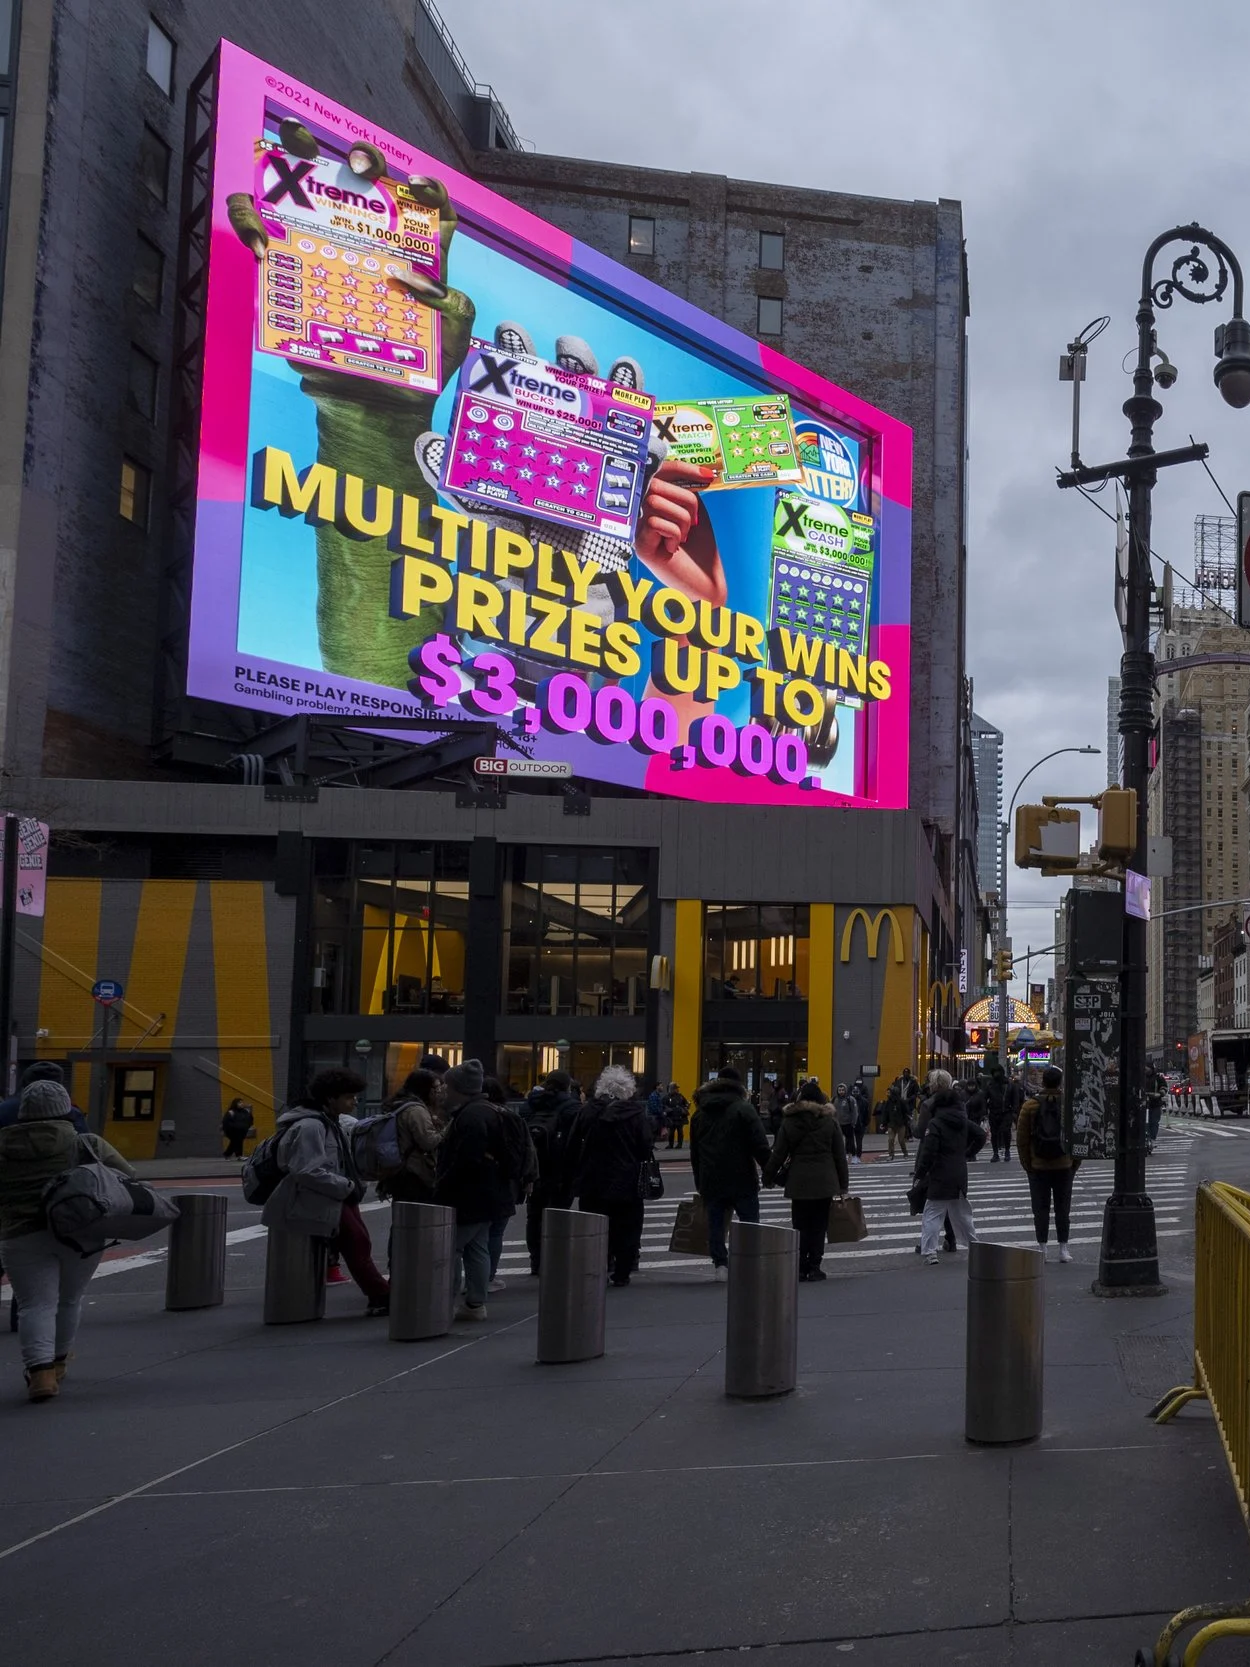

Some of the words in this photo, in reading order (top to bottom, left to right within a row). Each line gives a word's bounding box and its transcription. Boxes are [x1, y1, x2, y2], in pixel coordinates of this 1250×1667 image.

[265, 76, 311, 108] ©2024
[314, 101, 342, 125] New
[345, 115, 370, 142] York
[373, 134, 413, 165] Lottery
[259, 142, 269, 151] $5
[262, 155, 386, 215] Xtreme
[315, 196, 386, 225] WINNINGS
[397, 199, 412, 210] WIN
[333, 215, 350, 225] WIN
[404, 217, 430, 230] YOUR
[330, 219, 343, 228] UP
[343, 222, 355, 231] TO
[357, 222, 435, 254] $1,000,000!
[404, 224, 432, 238] PRIZE!
[289, 343, 297, 354] 3
[497, 348, 512, 357] YORK
[512, 353, 537, 365] LOTTERY
[469, 353, 577, 403] Xtreme
[545, 366, 562, 375] WIN
[554, 375, 577, 387] YOUR
[514, 388, 555, 406] BUCKS
[614, 389, 632, 400] MORE
[634, 396, 649, 406] PLAY
[516, 399, 531, 410] WIN
[531, 403, 544, 413] UP
[543, 406, 555, 417] TO
[557, 409, 602, 431] $25,000!
[653, 417, 713, 442] Xtreme
[678, 432, 711, 440] MATCH
[819, 434, 844, 458] NEW
[822, 450, 852, 477] YORK
[477, 483, 487, 494] 2
[488, 485, 509, 494] BONUS
[779, 491, 789, 499] $10
[537, 500, 566, 513] SCRATCH
[576, 510, 593, 520] CASH
[776, 500, 849, 538] Xtreme
[808, 530, 844, 548] CASH
[820, 548, 868, 566] $3,000,000!
[262, 446, 602, 603] MULTIPLY
[616, 571, 764, 662] YOUR
[779, 627, 891, 700] WINS
[402, 555, 641, 677] PRIZES
[663, 638, 741, 701] UP
[756, 667, 825, 727] TO
[234, 683, 294, 706] Gambling
[296, 697, 351, 716] problem?
[235, 666, 300, 691] PLEASE
[304, 681, 347, 701] PLAY
[350, 692, 455, 720] RESPONSIBLY
[419, 633, 821, 789] $3,000,000.
[479, 760, 504, 772] BIG
[509, 764, 567, 774] OUTDOOR
[22, 832, 46, 853] GENIE
[19, 854, 42, 868] GENIE
